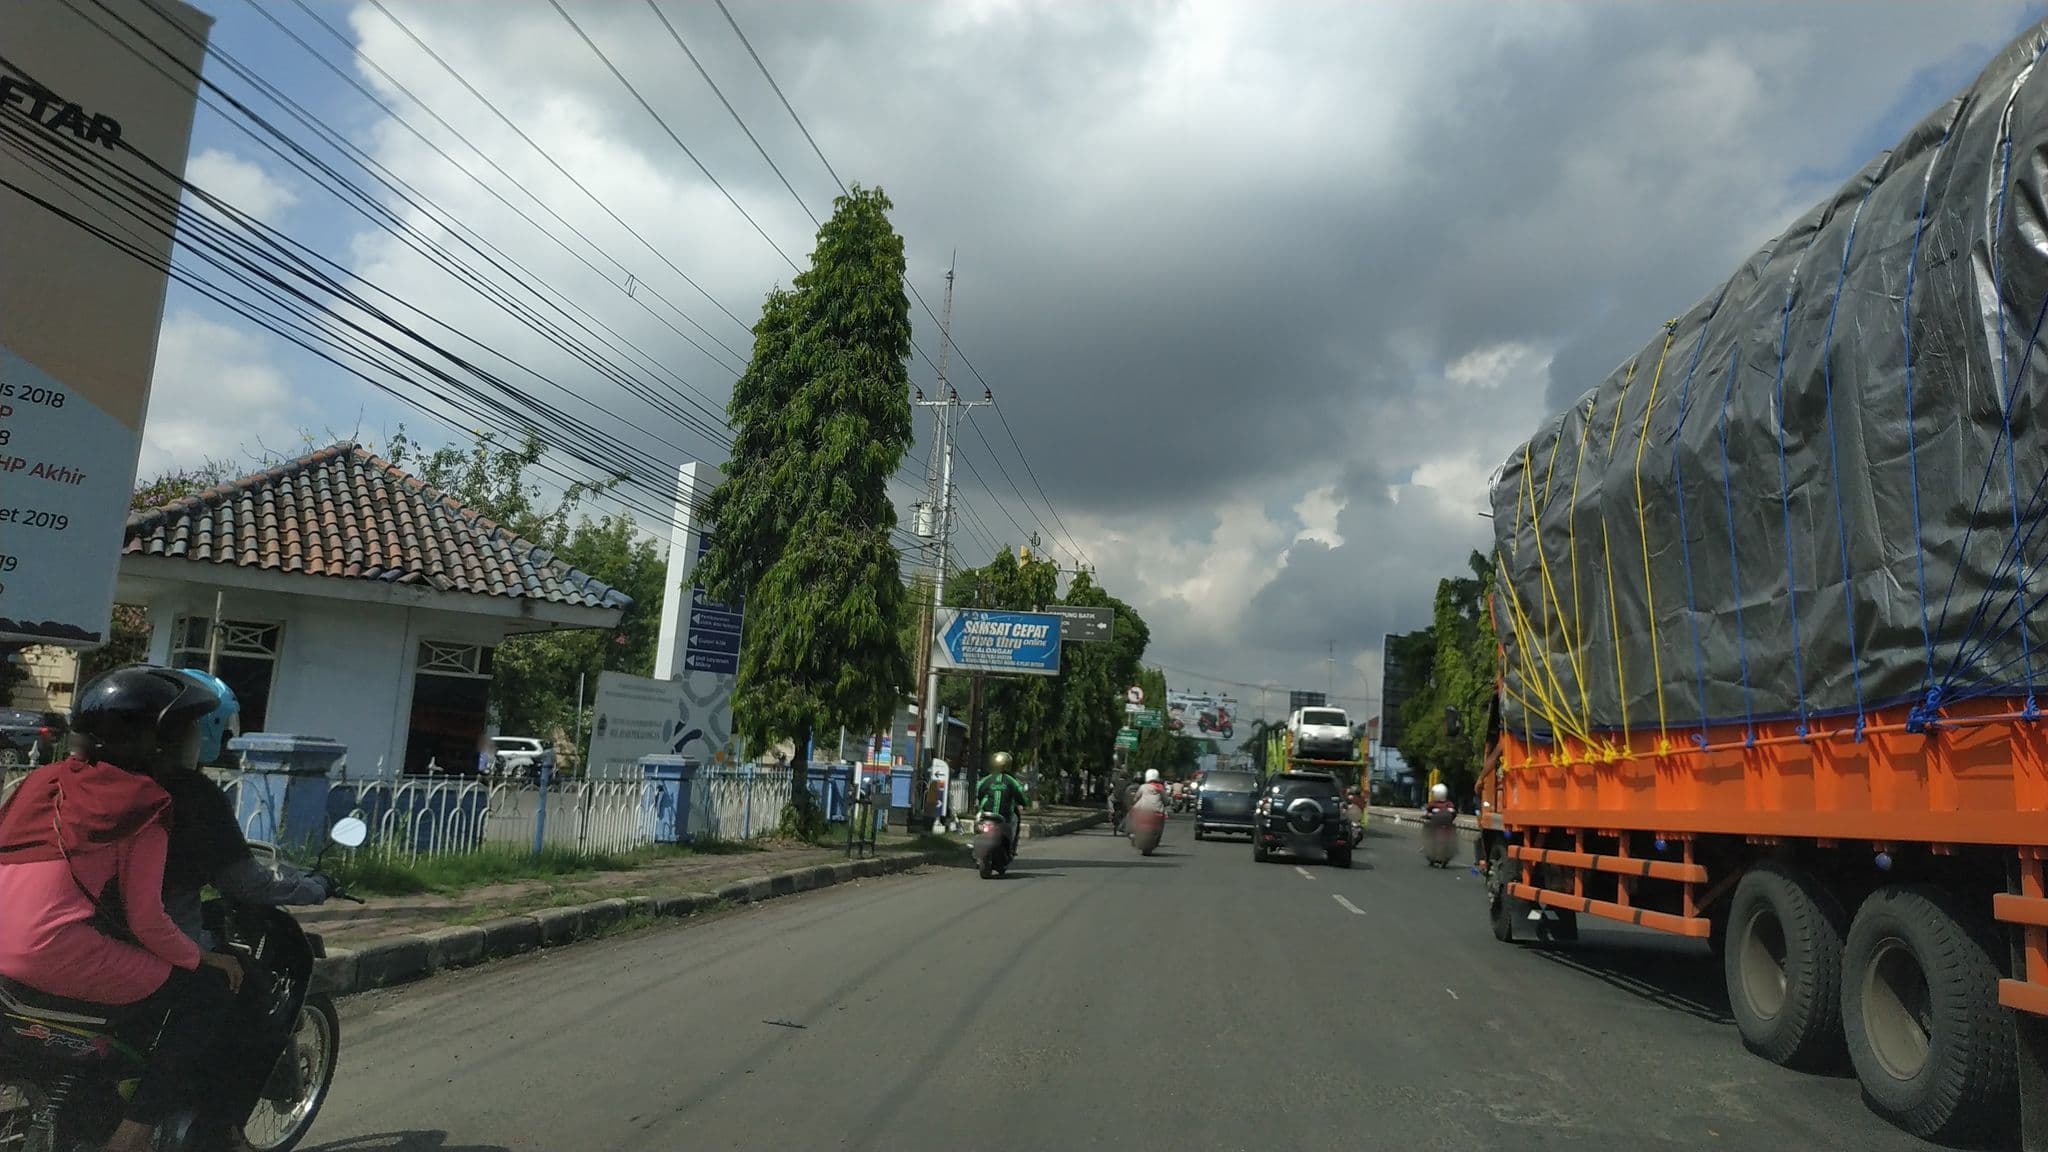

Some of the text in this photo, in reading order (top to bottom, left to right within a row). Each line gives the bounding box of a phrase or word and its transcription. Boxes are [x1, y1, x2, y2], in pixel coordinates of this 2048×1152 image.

[18, 385, 65, 408] 2018
[28, 462, 86, 486] Akhir
[22, 509, 68, 531] 2019
[964, 621, 1012, 637] SAMSAT
[1012, 624, 1049, 639] CEPAT
